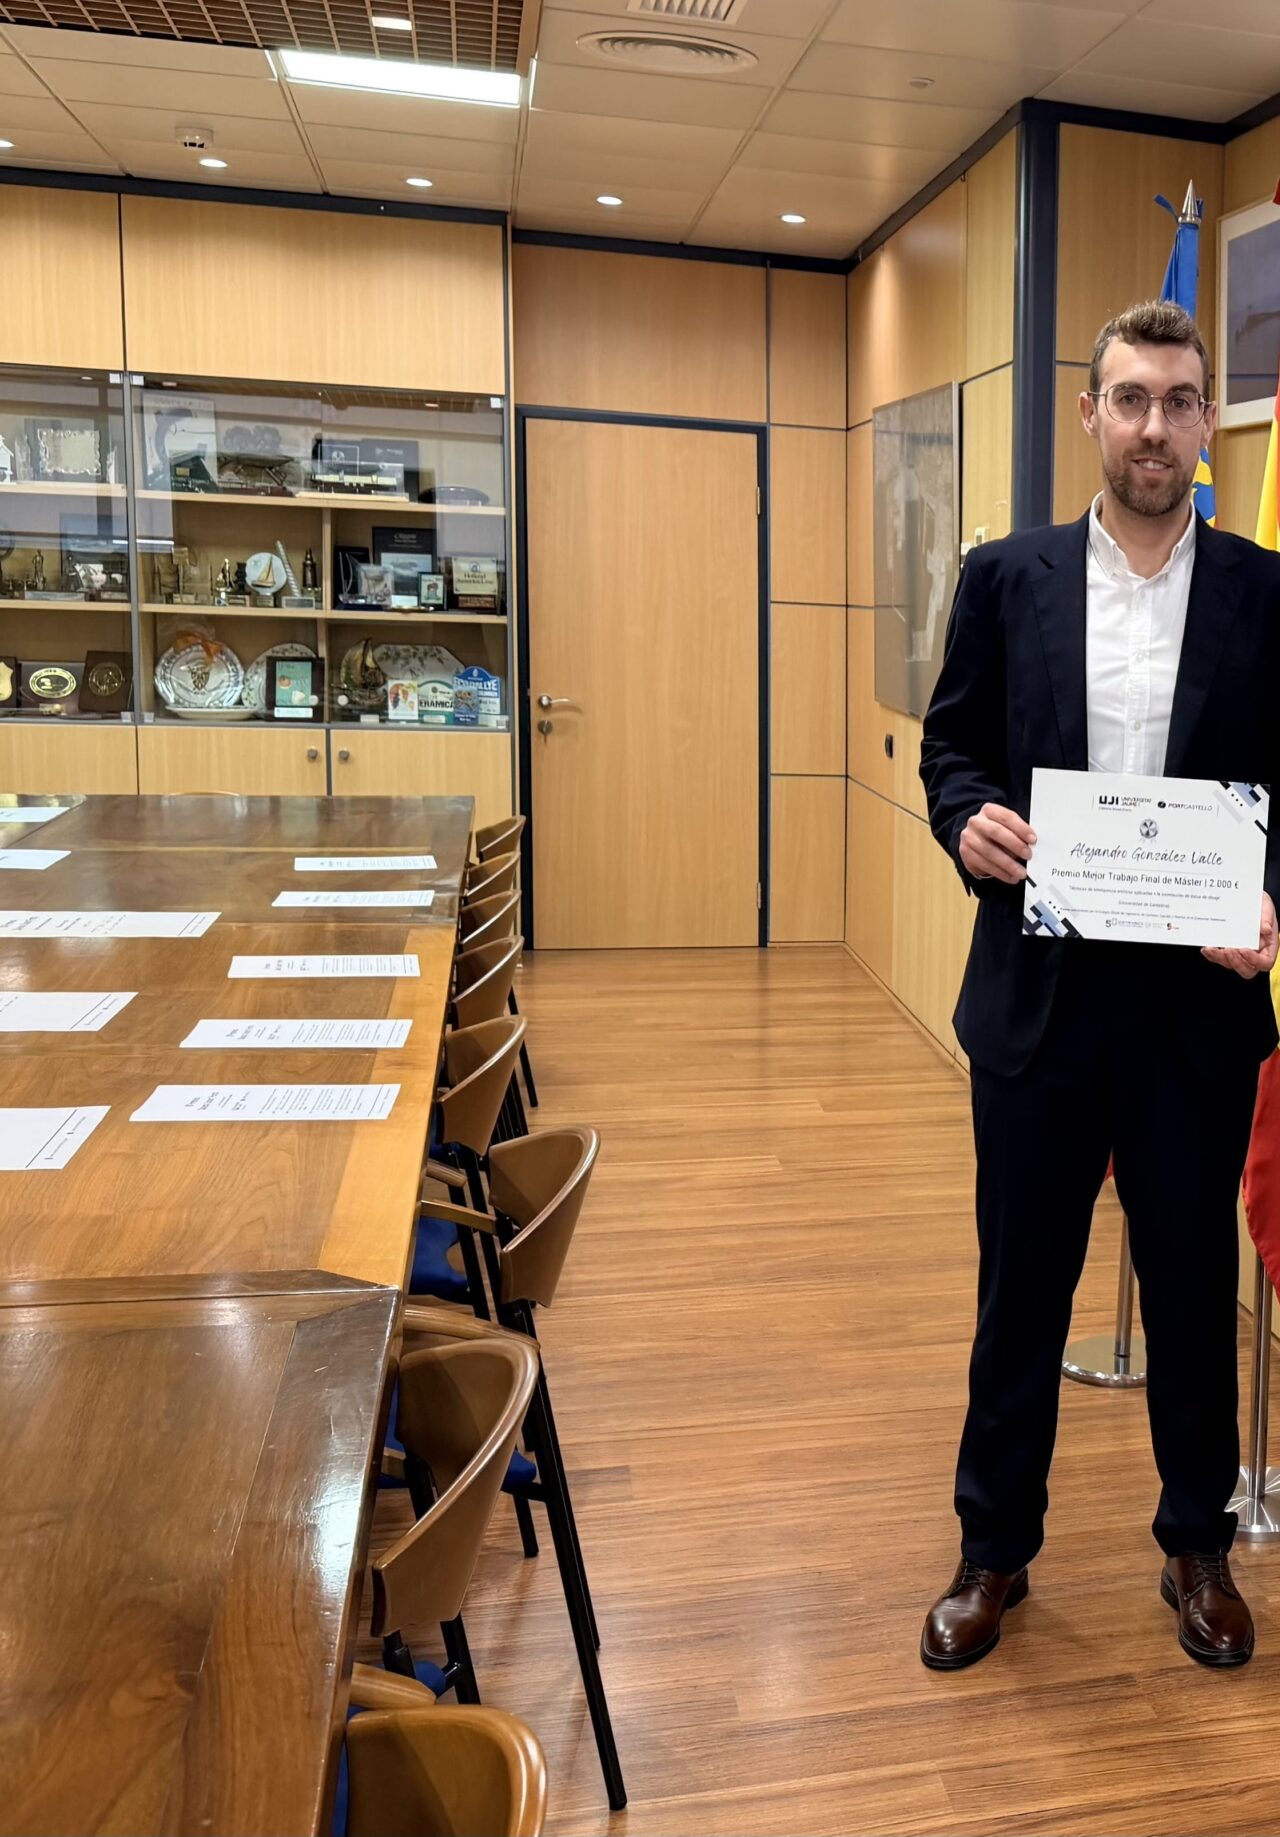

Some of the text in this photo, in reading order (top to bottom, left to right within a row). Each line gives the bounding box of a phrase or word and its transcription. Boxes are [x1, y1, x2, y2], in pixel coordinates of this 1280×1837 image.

[1099, 795, 1119, 805] UJI
[1070, 842, 1223, 865] Alejandro González Valle
[1051, 868, 1080, 878] Premio
[1082, 870, 1105, 881] Mejor
[1108, 872, 1138, 884] Trabajo
[1140, 874, 1160, 884] Final
[1162, 876, 1172, 884] de
[1174, 876, 1202, 887] Máster
[1234, 880, 1240, 889] €
